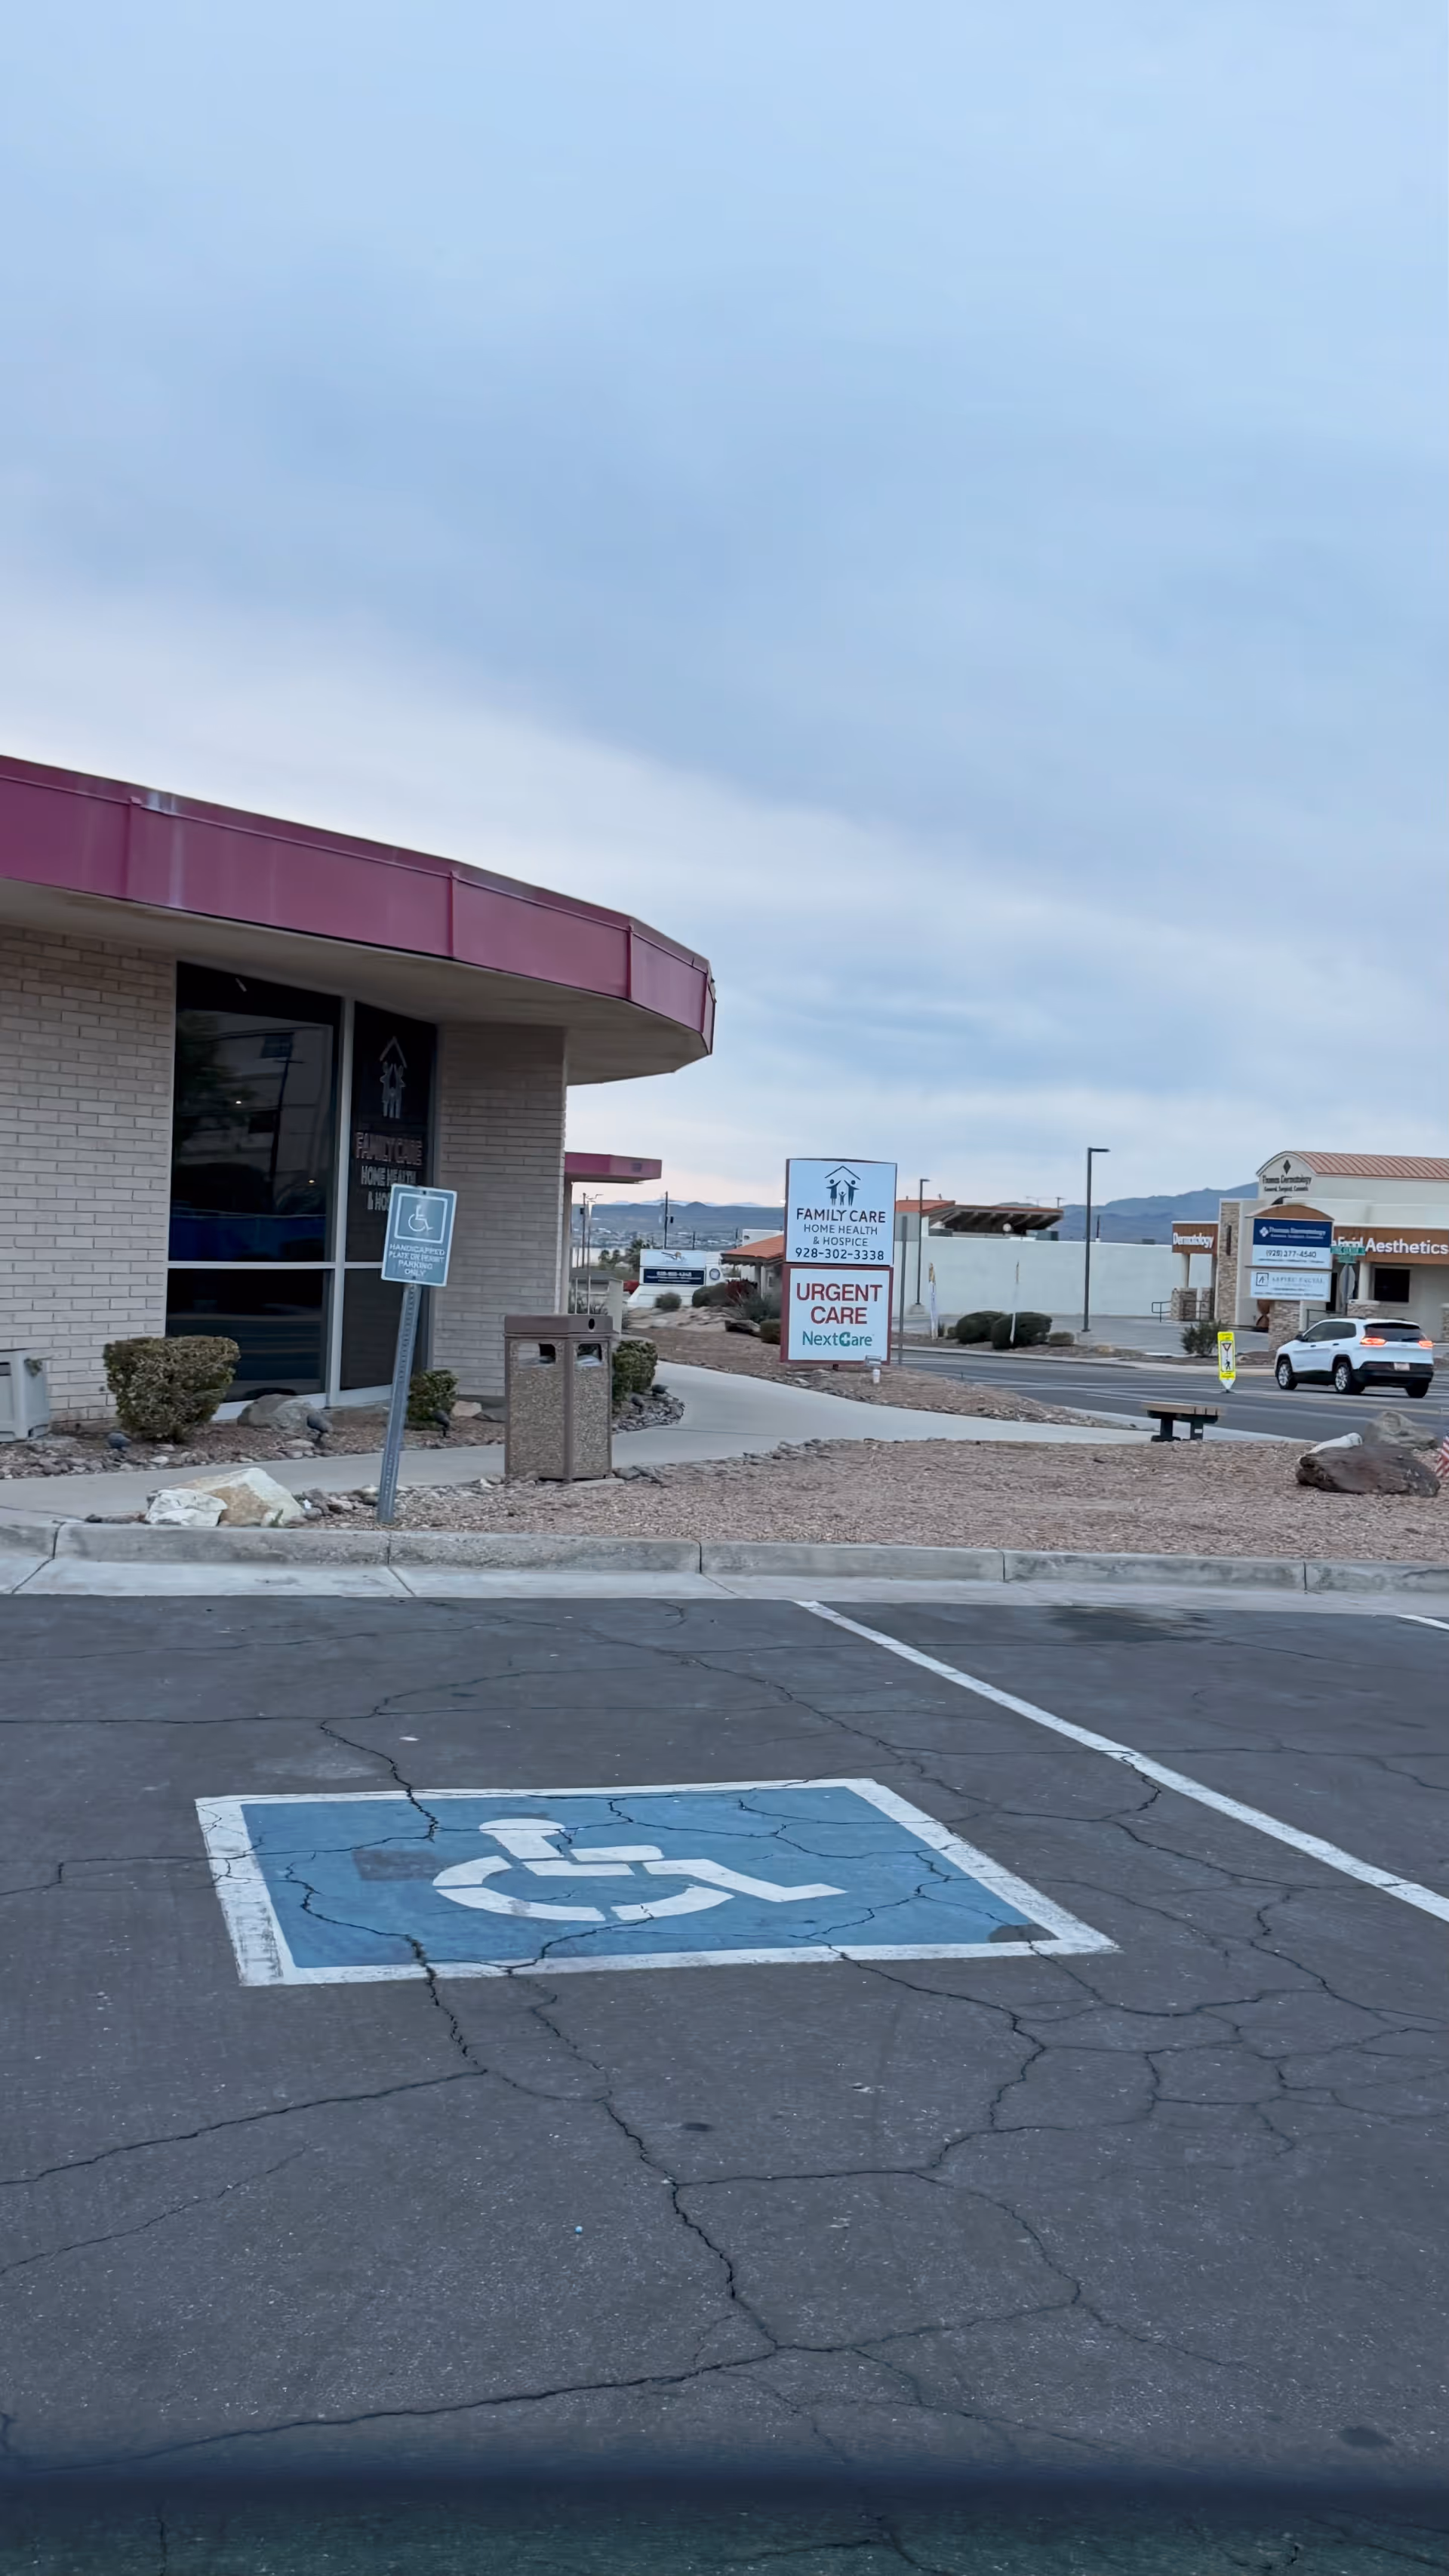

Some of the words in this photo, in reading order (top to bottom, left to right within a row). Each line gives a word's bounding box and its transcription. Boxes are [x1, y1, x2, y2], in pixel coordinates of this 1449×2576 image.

[361, 1165, 386, 1186] HOME
[386, 1167, 417, 1187] HEALTH
[796, 1208, 847, 1222] FAMILY
[849, 1210, 886, 1223] CARE
[804, 1223, 835, 1234] HOME
[838, 1225, 878, 1236] HEALTH
[813, 1236, 820, 1245] &
[823, 1236, 869, 1247] HOSPICE
[1365, 1237, 1449, 1254] Aesthetics
[389, 1243, 445, 1256] HANDICAPPED
[389, 1250, 409, 1260] PLATE
[795, 1247, 884, 1260] 928-302-3338
[398, 1259, 433, 1270] PARKING
[404, 1268, 427, 1276] ONLY
[796, 1282, 883, 1302] URGENT
[811, 1306, 868, 1325] CARE
[802, 1331, 872, 1346] NextCare
